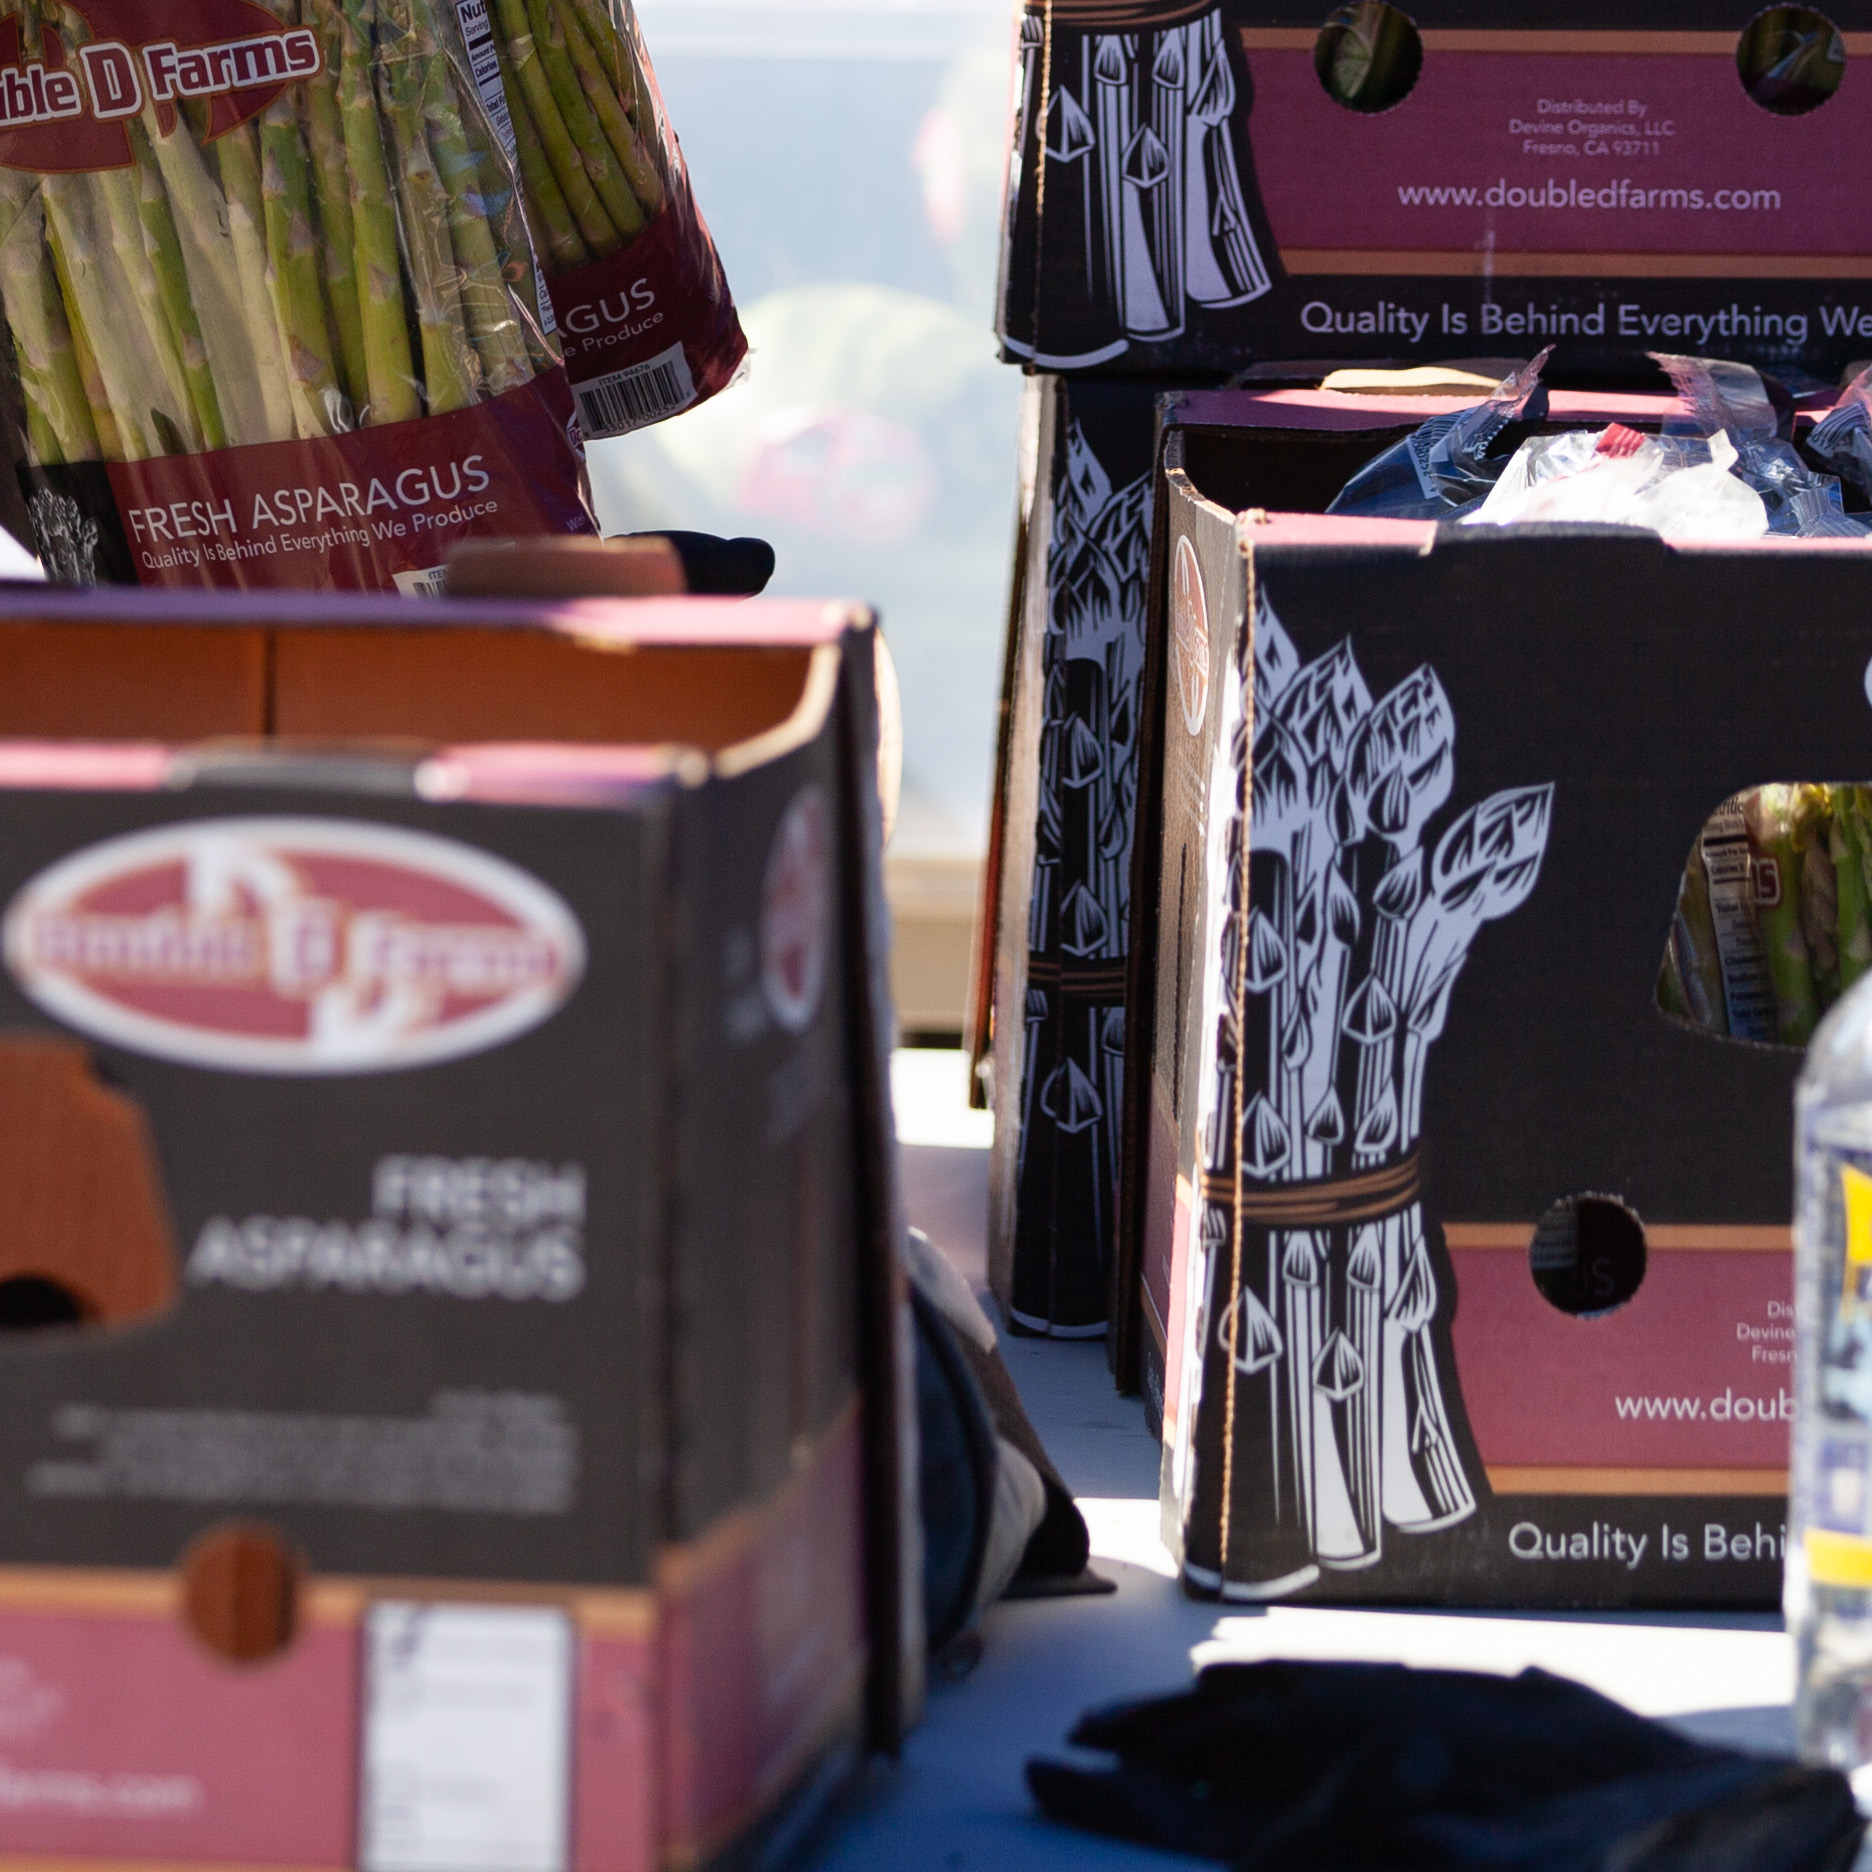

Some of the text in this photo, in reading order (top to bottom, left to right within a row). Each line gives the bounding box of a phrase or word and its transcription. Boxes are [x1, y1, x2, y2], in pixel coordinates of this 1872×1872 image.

[79, 41, 143, 119] D
[142, 29, 321, 101] Farms
[1536, 98, 1648, 118] Distributed By
[1644, 120, 1676, 136] LLC
[1583, 140, 1610, 156] CA
[1612, 140, 1660, 156] 93711
[1396, 178, 1782, 210] www.doubledfarms.com
[581, 312, 664, 352] Produce
[1300, 300, 1429, 343] Quality
[1441, 303, 1468, 334] Is
[1481, 302, 1605, 335] Behind
[1618, 303, 1808, 346] Everything
[599, 374, 621, 387] ITEM
[128, 454, 490, 543] FRESH ASPARAGUS
[141, 497, 499, 571] Quality Is Behind Everything We Produce
[1508, 1520, 1648, 1570] Quality
[1662, 1523, 1689, 1560] Is
[1704, 1521, 1786, 1560] Behi
